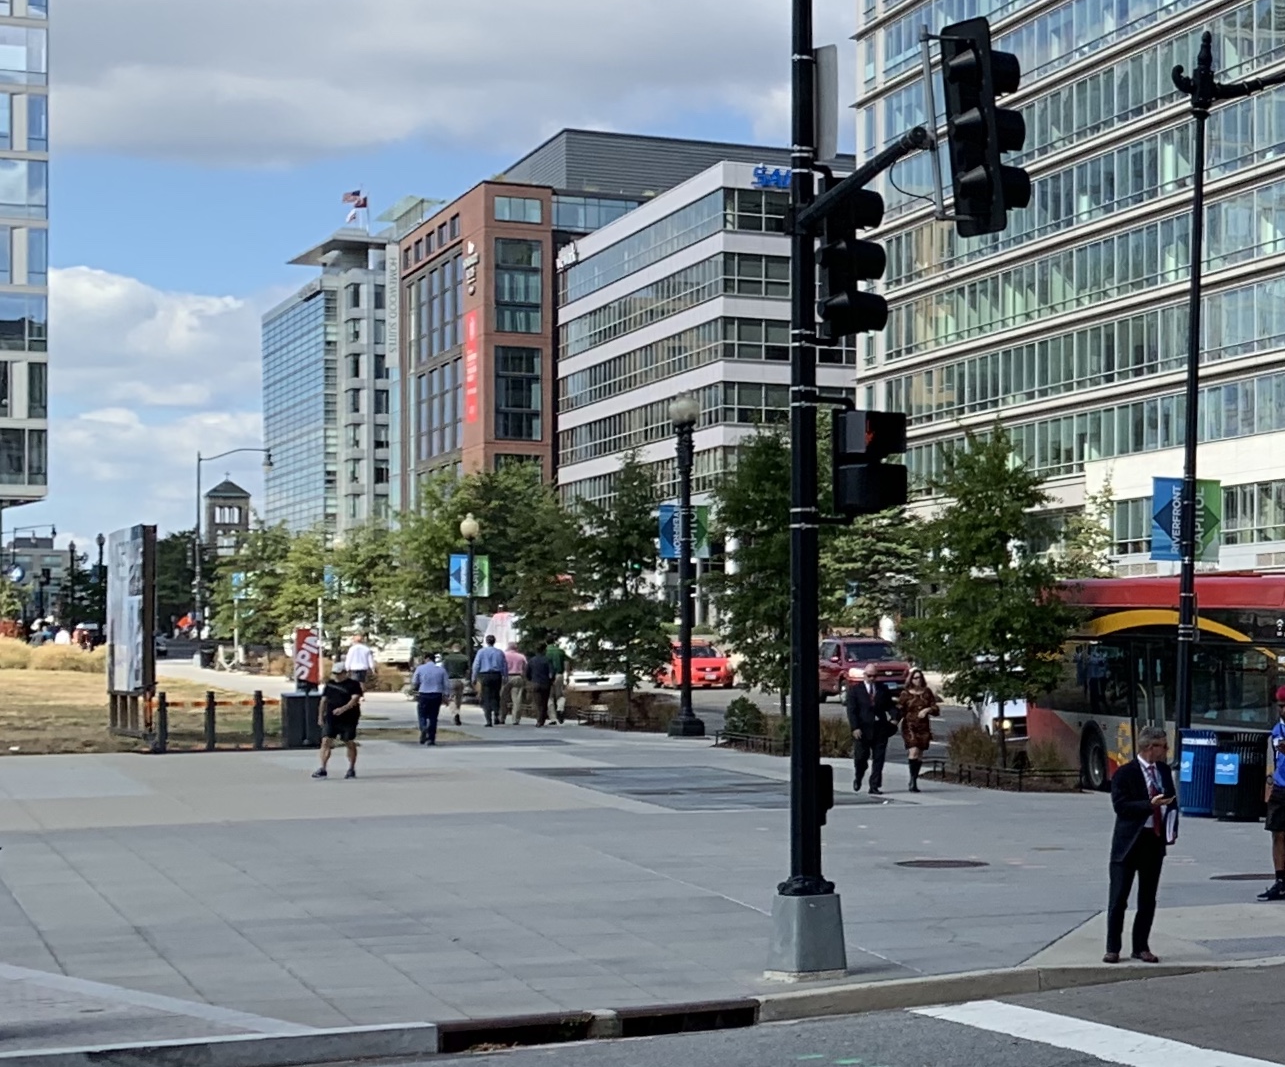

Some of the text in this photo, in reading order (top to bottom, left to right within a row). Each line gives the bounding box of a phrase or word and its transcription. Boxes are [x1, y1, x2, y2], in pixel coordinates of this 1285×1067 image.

[388, 257, 398, 354] HOMEWOOD SUITES
[1171, 485, 1182, 554] RIVERFRONT
[1194, 486, 1205, 555] CAPITOL
